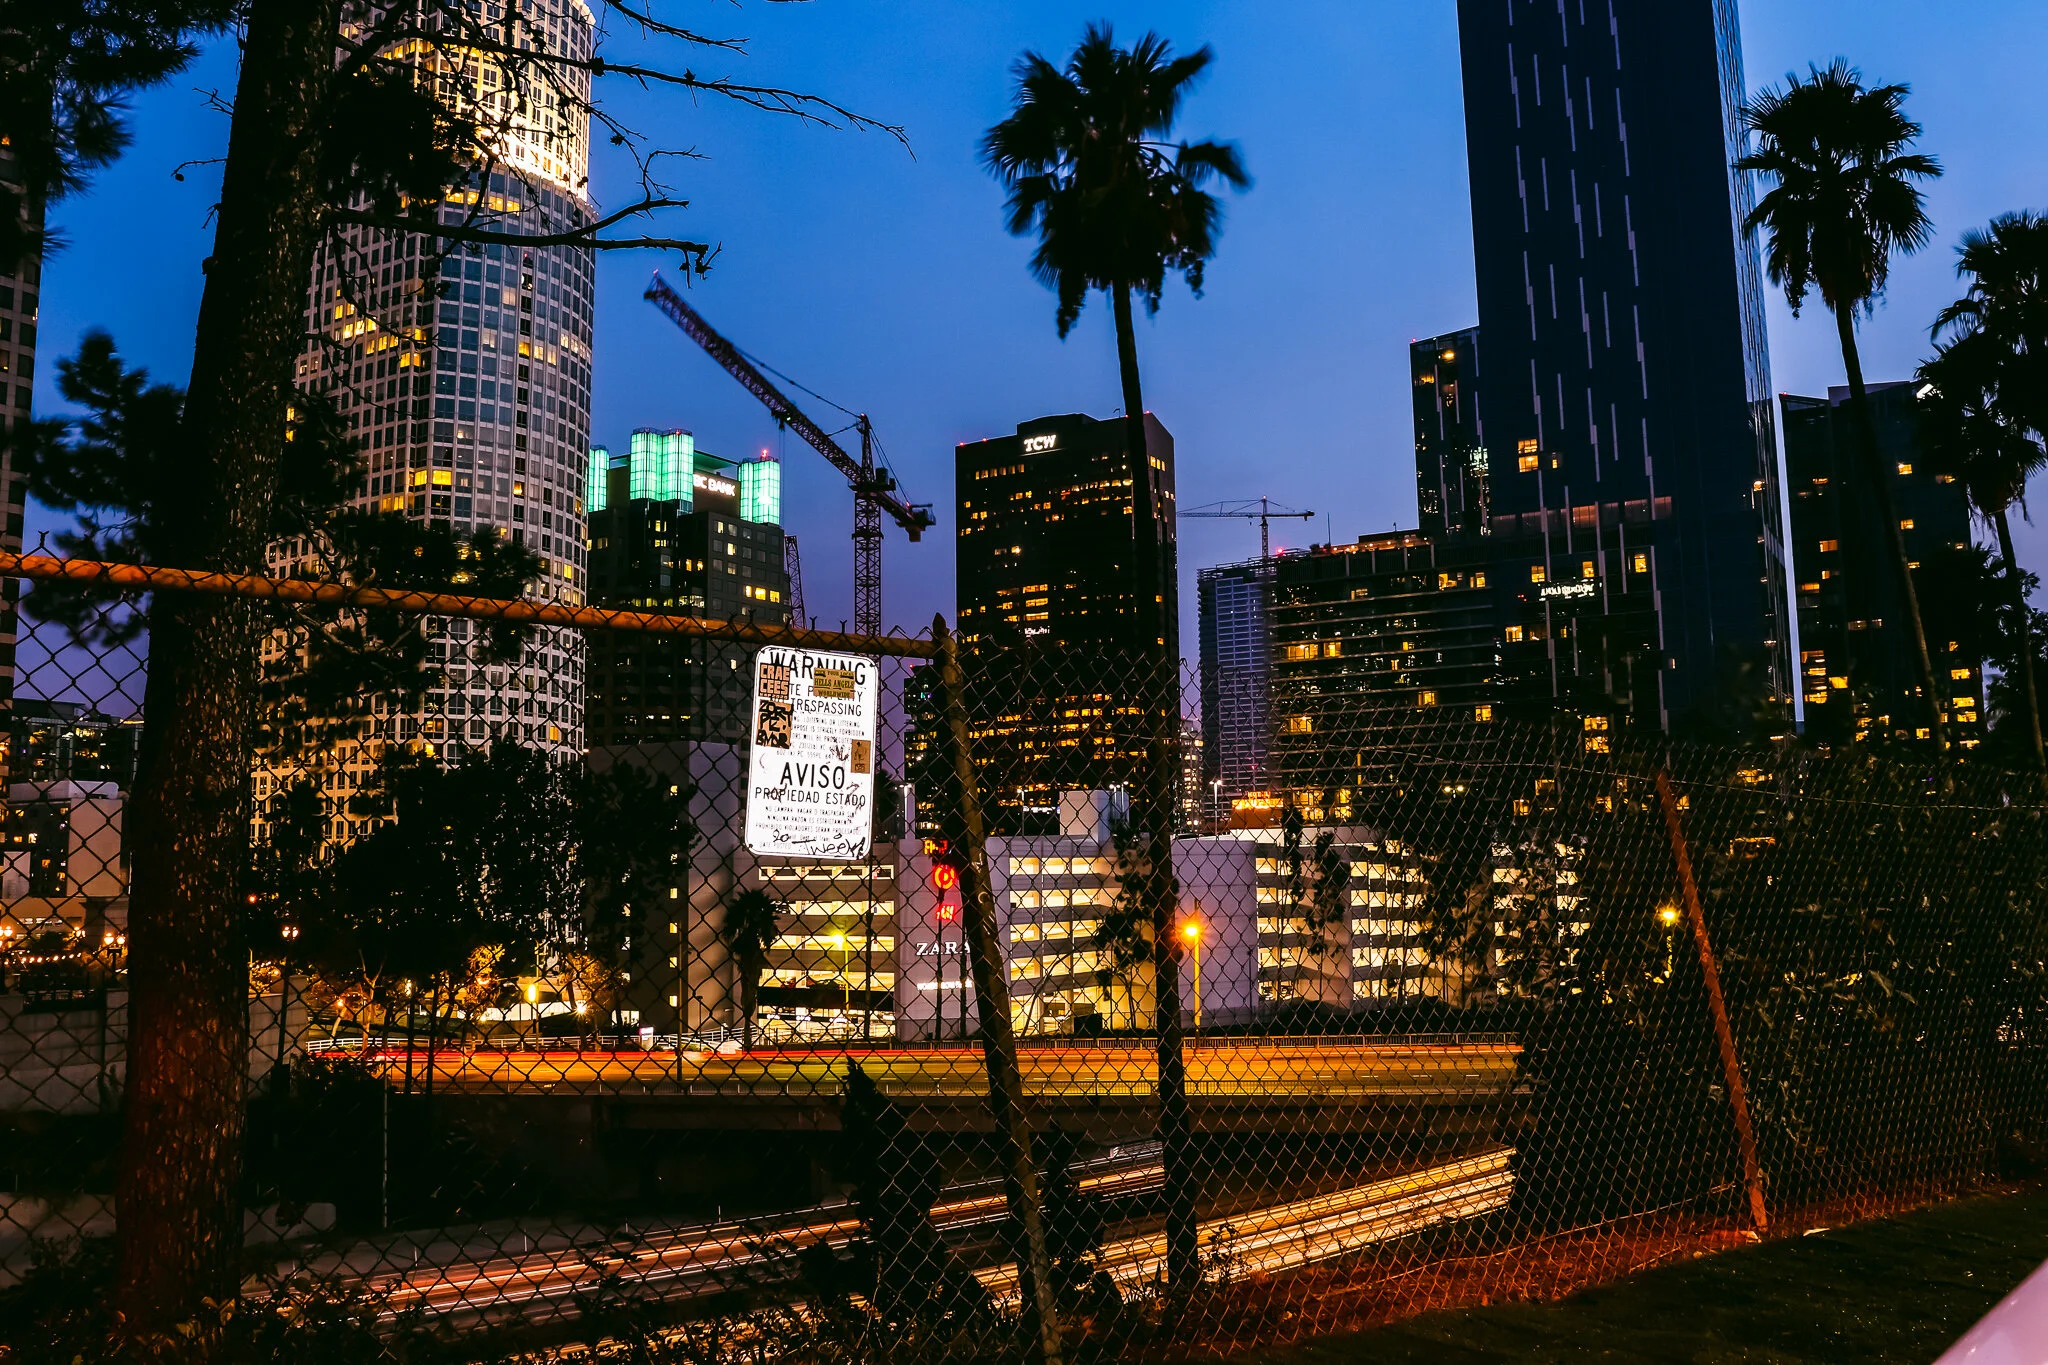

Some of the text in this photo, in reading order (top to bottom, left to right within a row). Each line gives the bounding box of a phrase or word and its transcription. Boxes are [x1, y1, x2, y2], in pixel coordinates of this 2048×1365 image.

[1023, 434, 1057, 453] TCW
[708, 478, 736, 497] BANK
[791, 697, 862, 717] TRESPASSING
[779, 762, 845, 790] AVISO
[755, 787, 867, 807] PROPIEDAD ESTADO
[916, 941, 971, 956] ZARA
